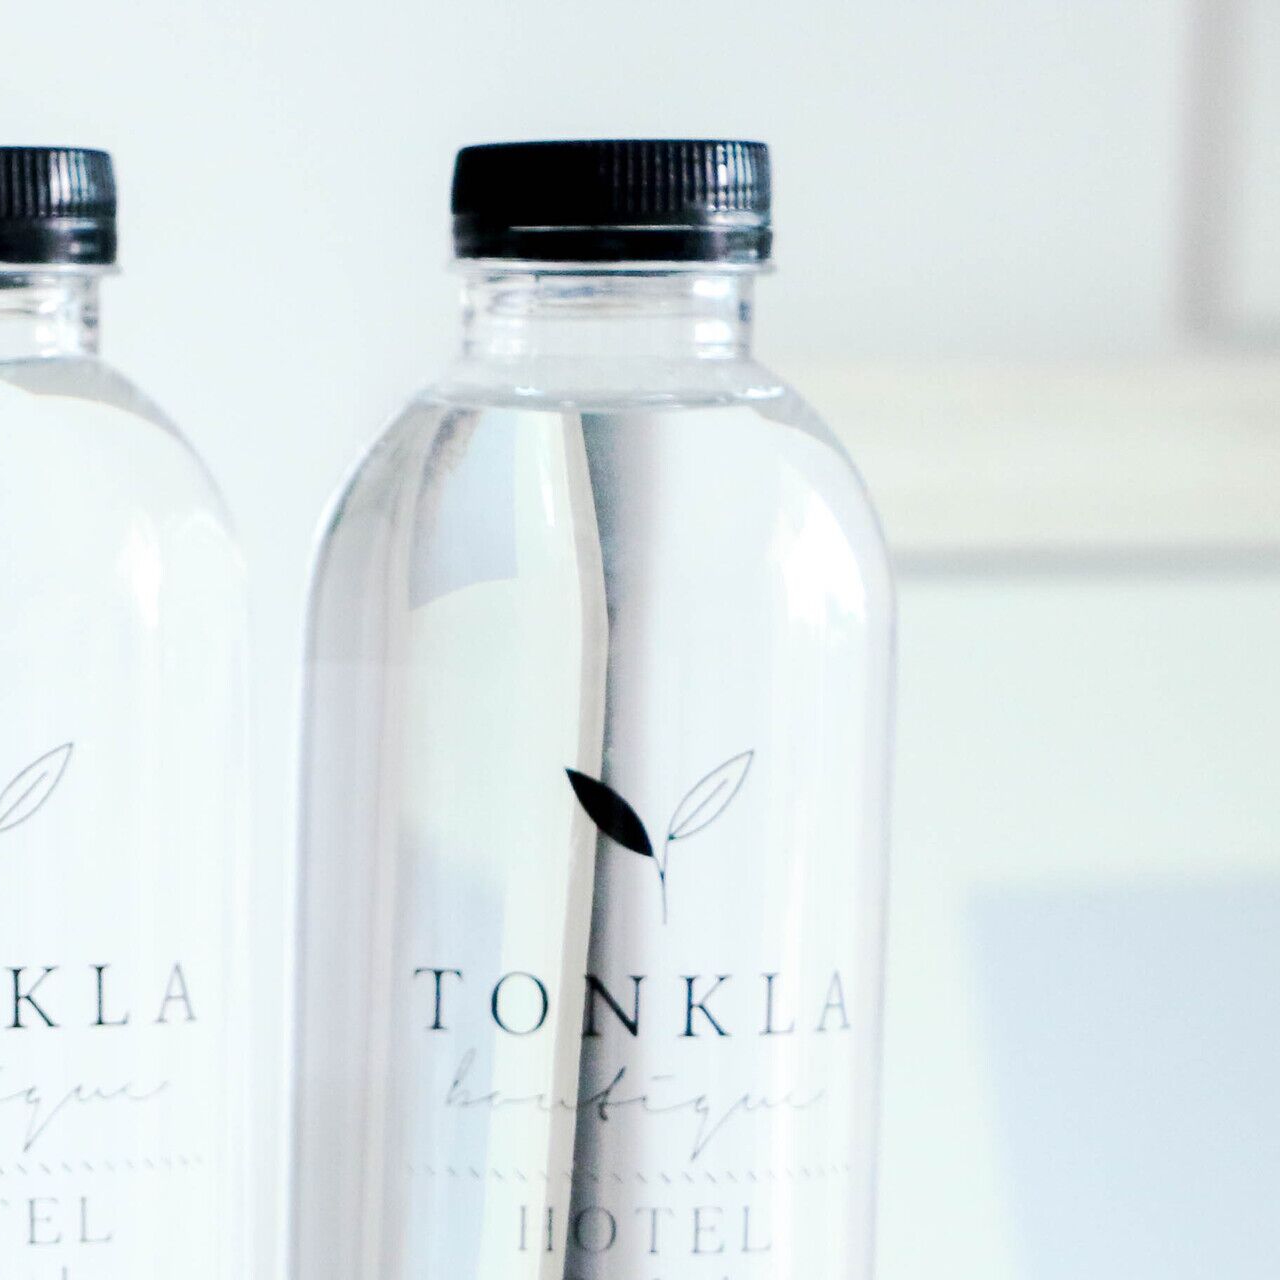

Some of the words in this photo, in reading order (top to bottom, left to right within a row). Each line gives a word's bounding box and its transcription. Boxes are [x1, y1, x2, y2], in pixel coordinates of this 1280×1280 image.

[413, 967, 852, 1038] TONKLA
[444, 1047, 827, 1163] boutique
[517, 1205, 773, 1254] HOTEL
